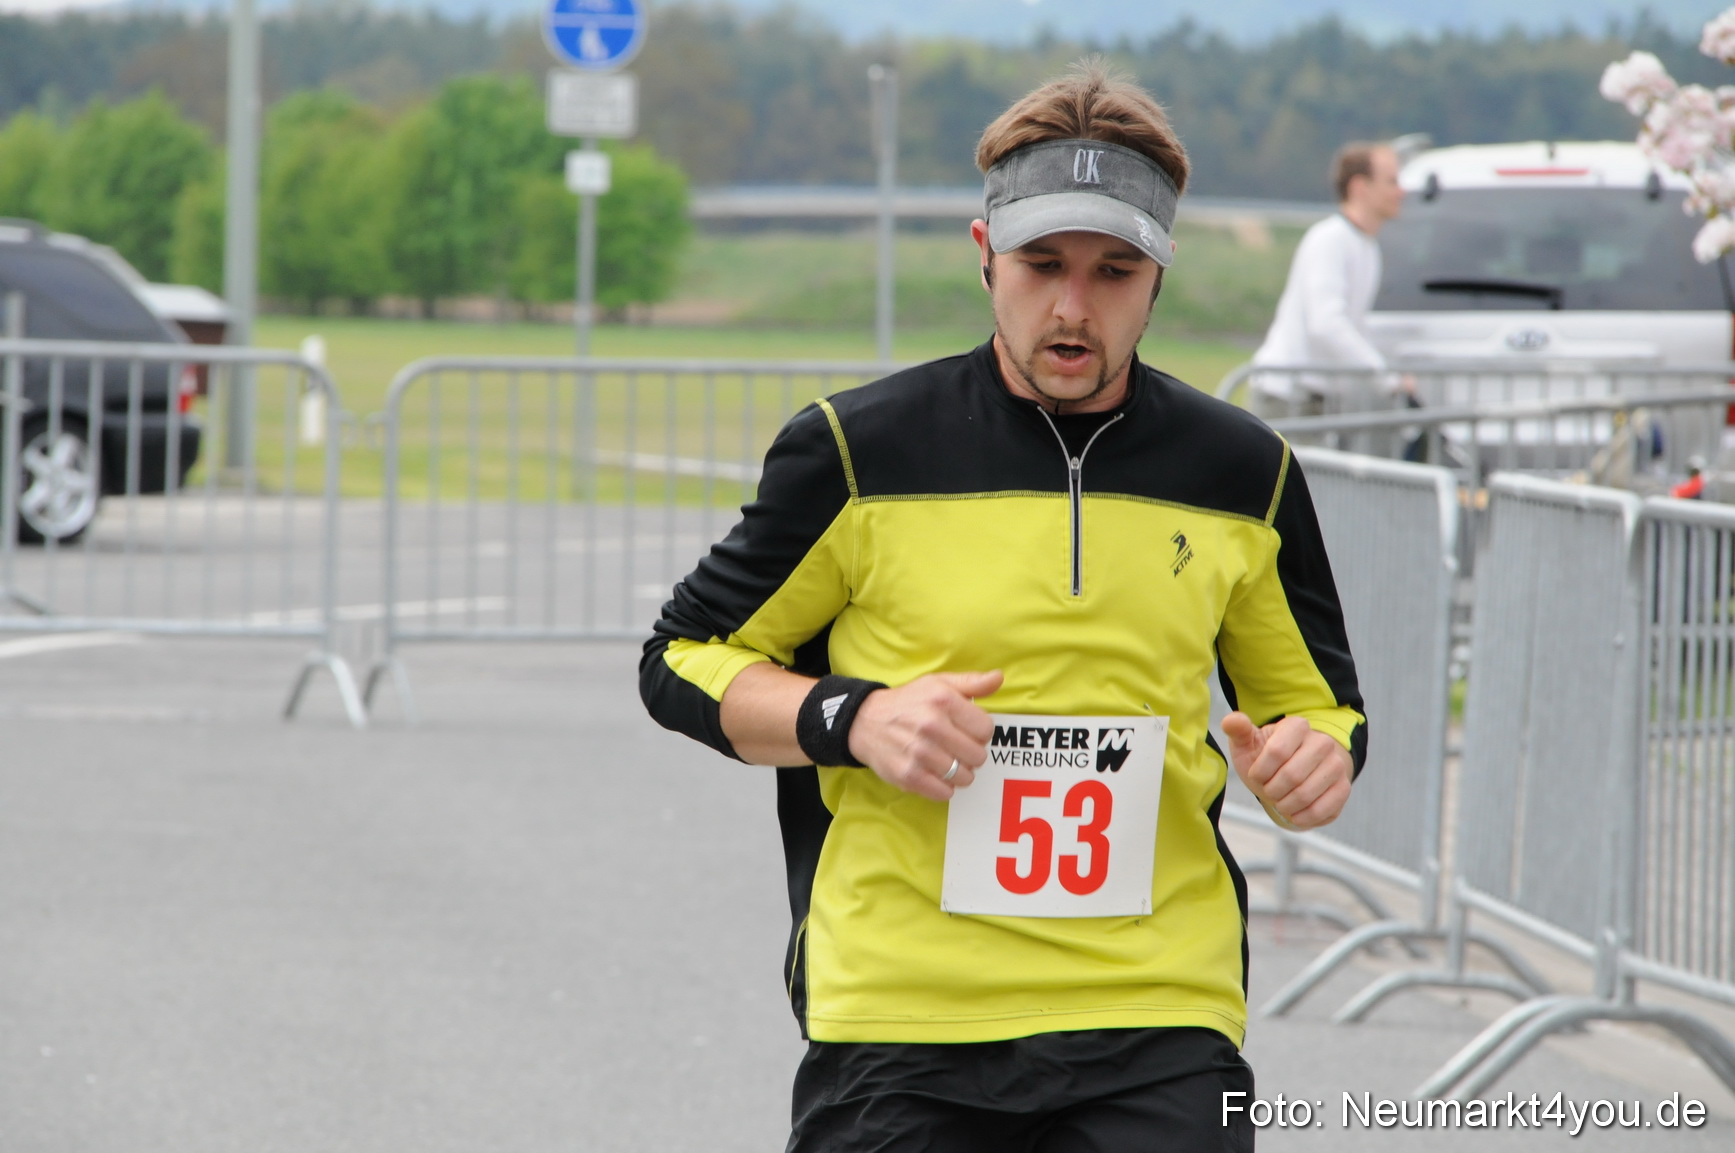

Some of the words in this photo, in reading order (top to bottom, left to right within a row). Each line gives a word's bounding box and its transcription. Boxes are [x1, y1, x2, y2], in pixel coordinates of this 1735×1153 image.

[1073, 148, 1104, 184] CK
[991, 726, 1090, 749] MEYER
[991, 750, 1089, 768] WERBUNG
[996, 778, 1113, 896] 53
